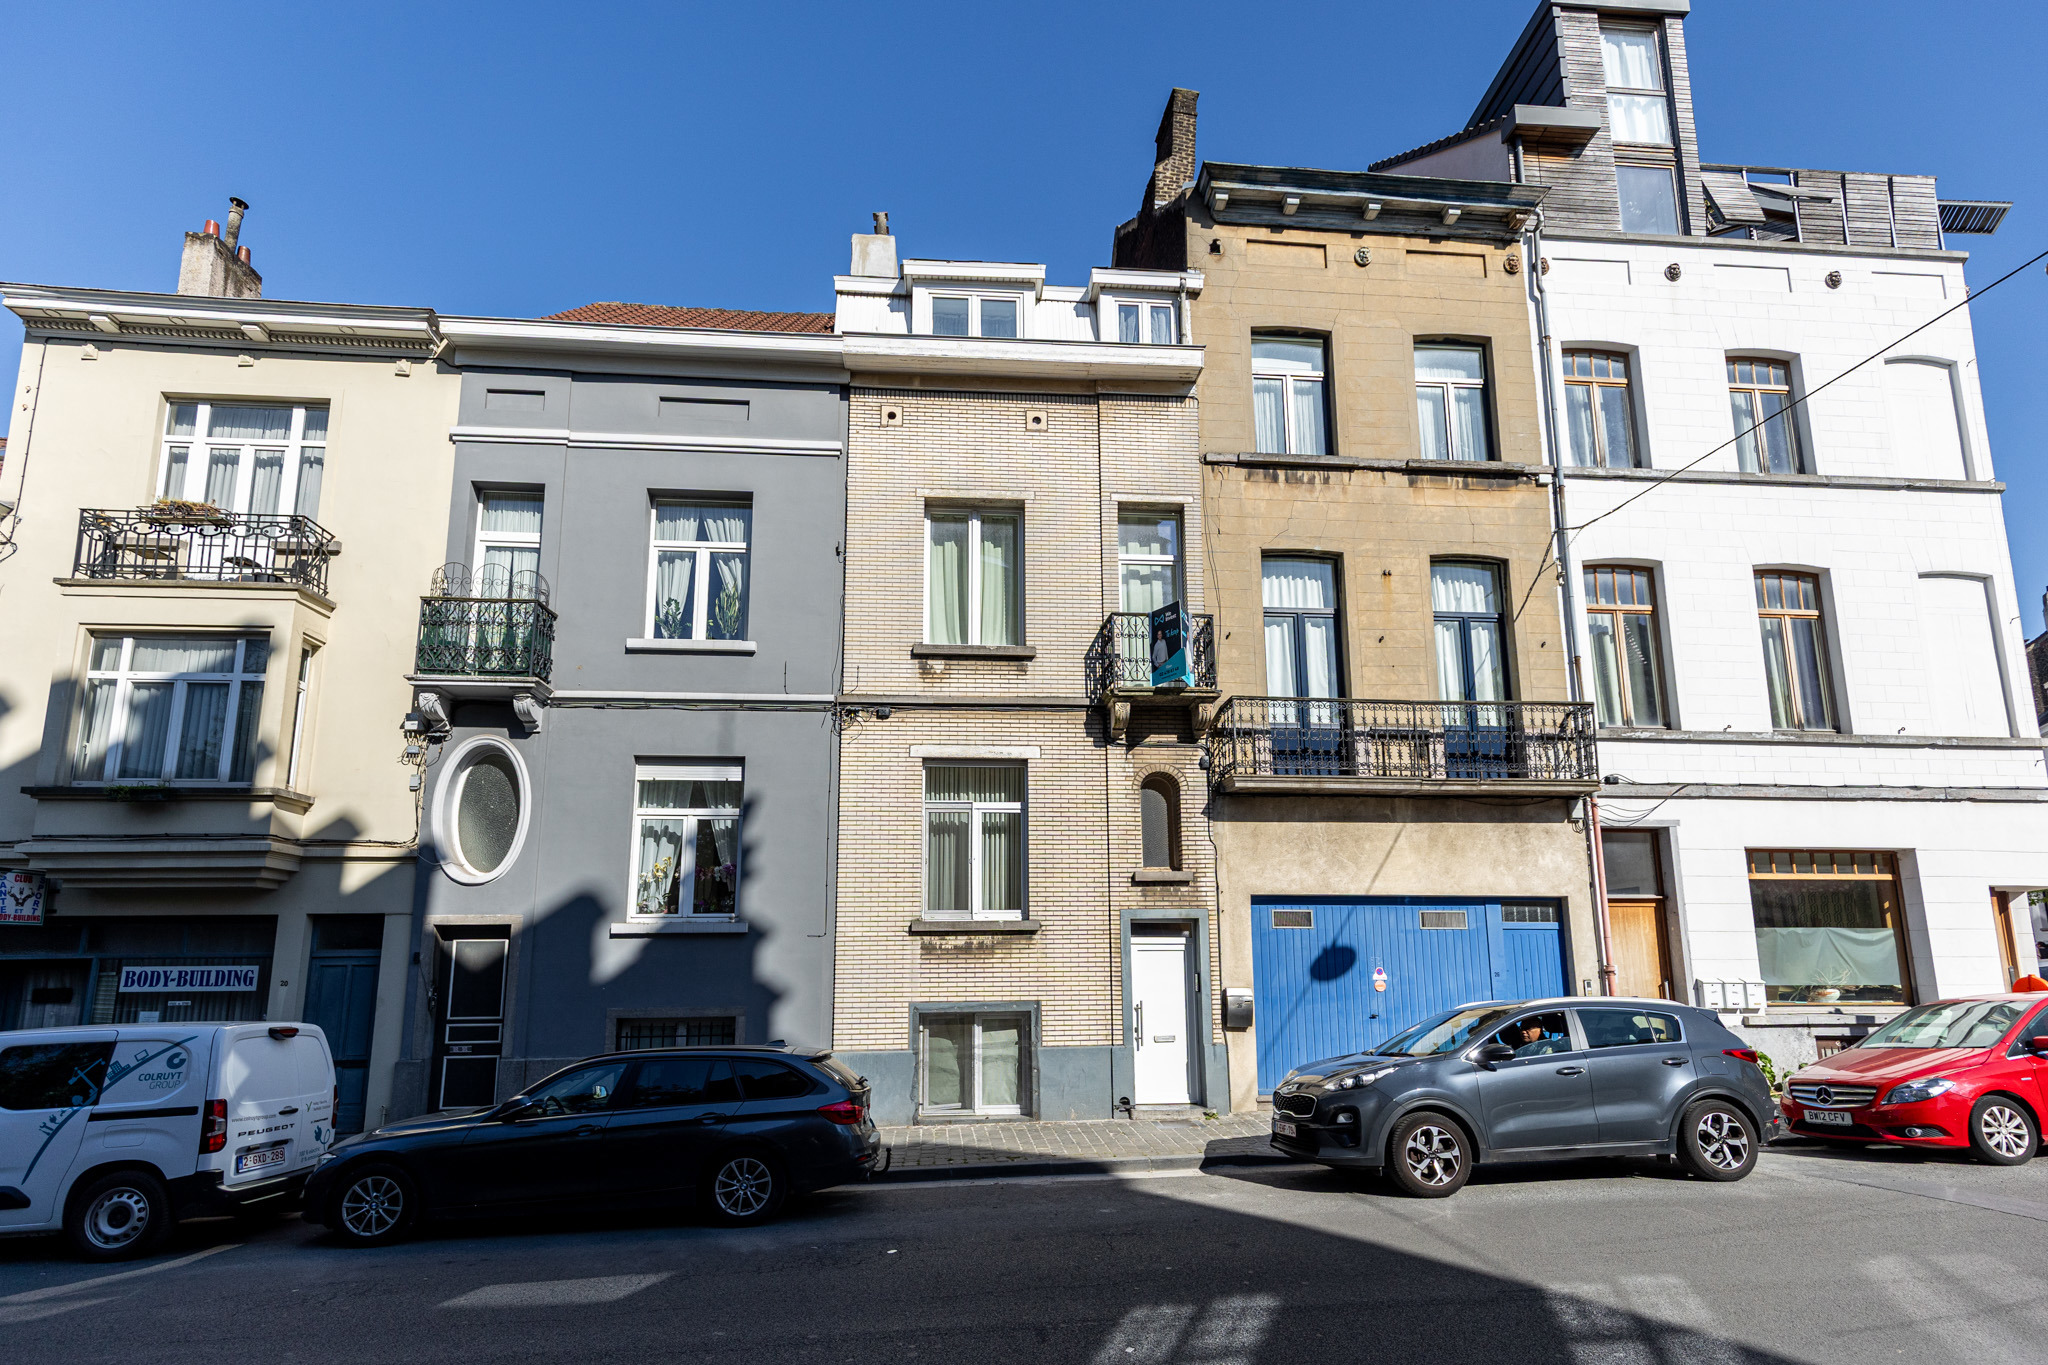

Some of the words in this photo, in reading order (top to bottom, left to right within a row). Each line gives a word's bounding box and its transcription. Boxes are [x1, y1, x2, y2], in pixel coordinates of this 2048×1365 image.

[14, 873, 33, 883] CLUB
[31, 876, 46, 915] SPORT
[0, 913, 41, 922] ODY-BUILDING
[122, 969, 256, 988] BODY-BUILDING
[138, 1071, 184, 1082] COLRUYT
[149, 1080, 181, 1090] GROUP
[231, 1113, 277, 1123] www.colruytgroup.com
[1808, 1111, 1827, 1121] BW12
[1827, 1112, 1846, 1122] CFV
[237, 1122, 296, 1137] PEUGEOT
